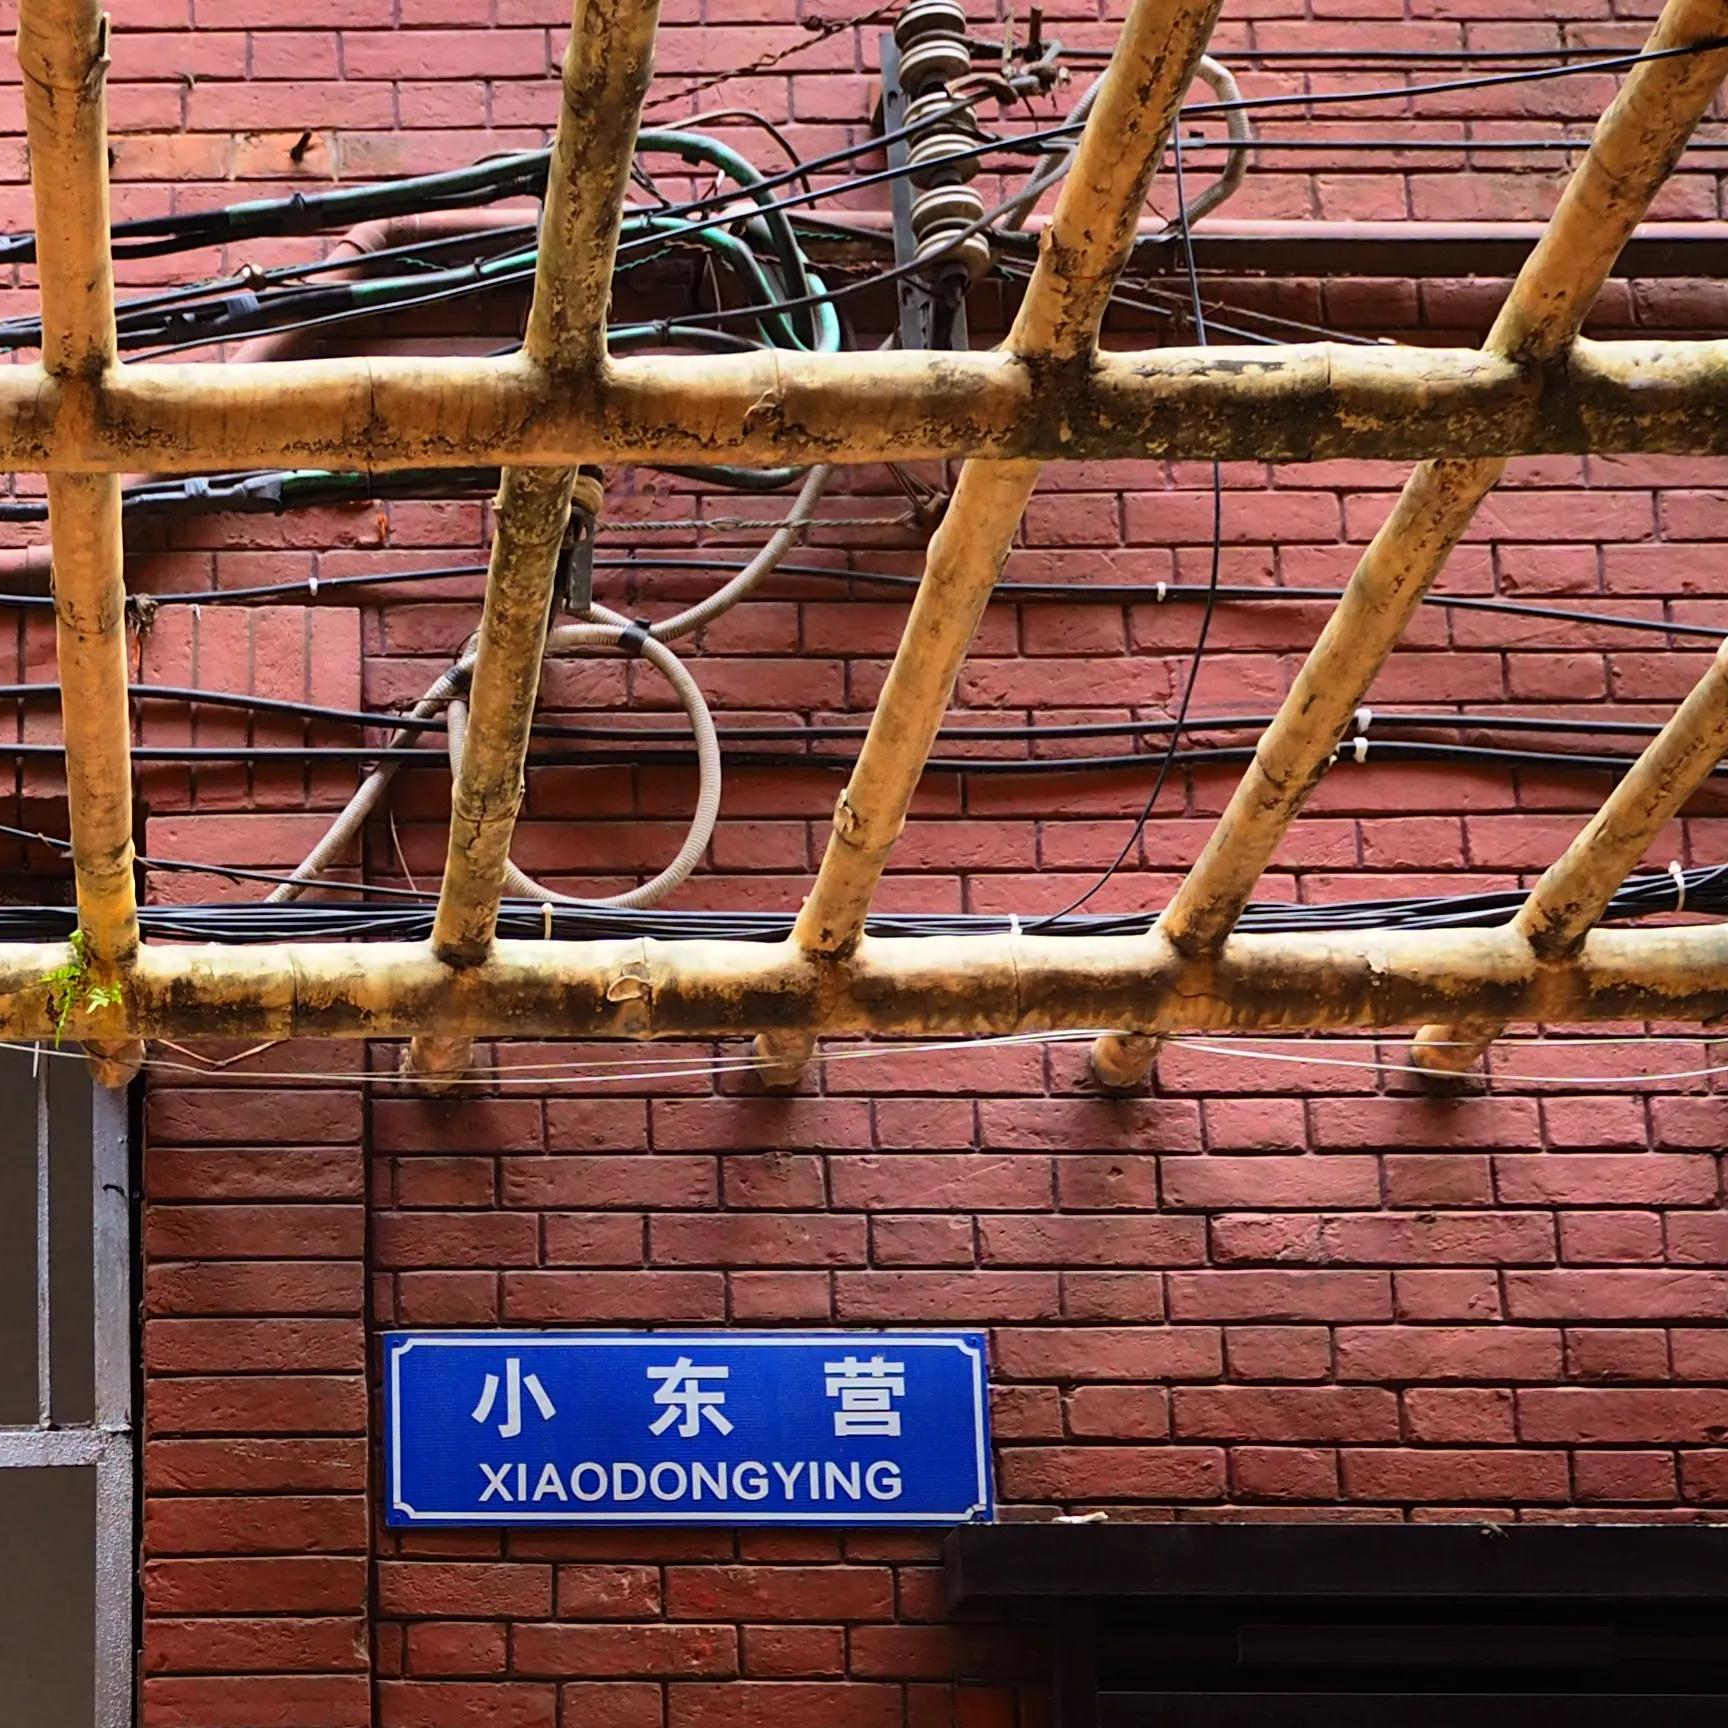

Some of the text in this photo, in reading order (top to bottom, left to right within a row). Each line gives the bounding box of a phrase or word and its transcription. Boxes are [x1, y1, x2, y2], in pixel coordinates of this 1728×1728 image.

[472, 1357, 905, 1438] 小东营
[479, 1461, 903, 1502] XIAODONGYING
